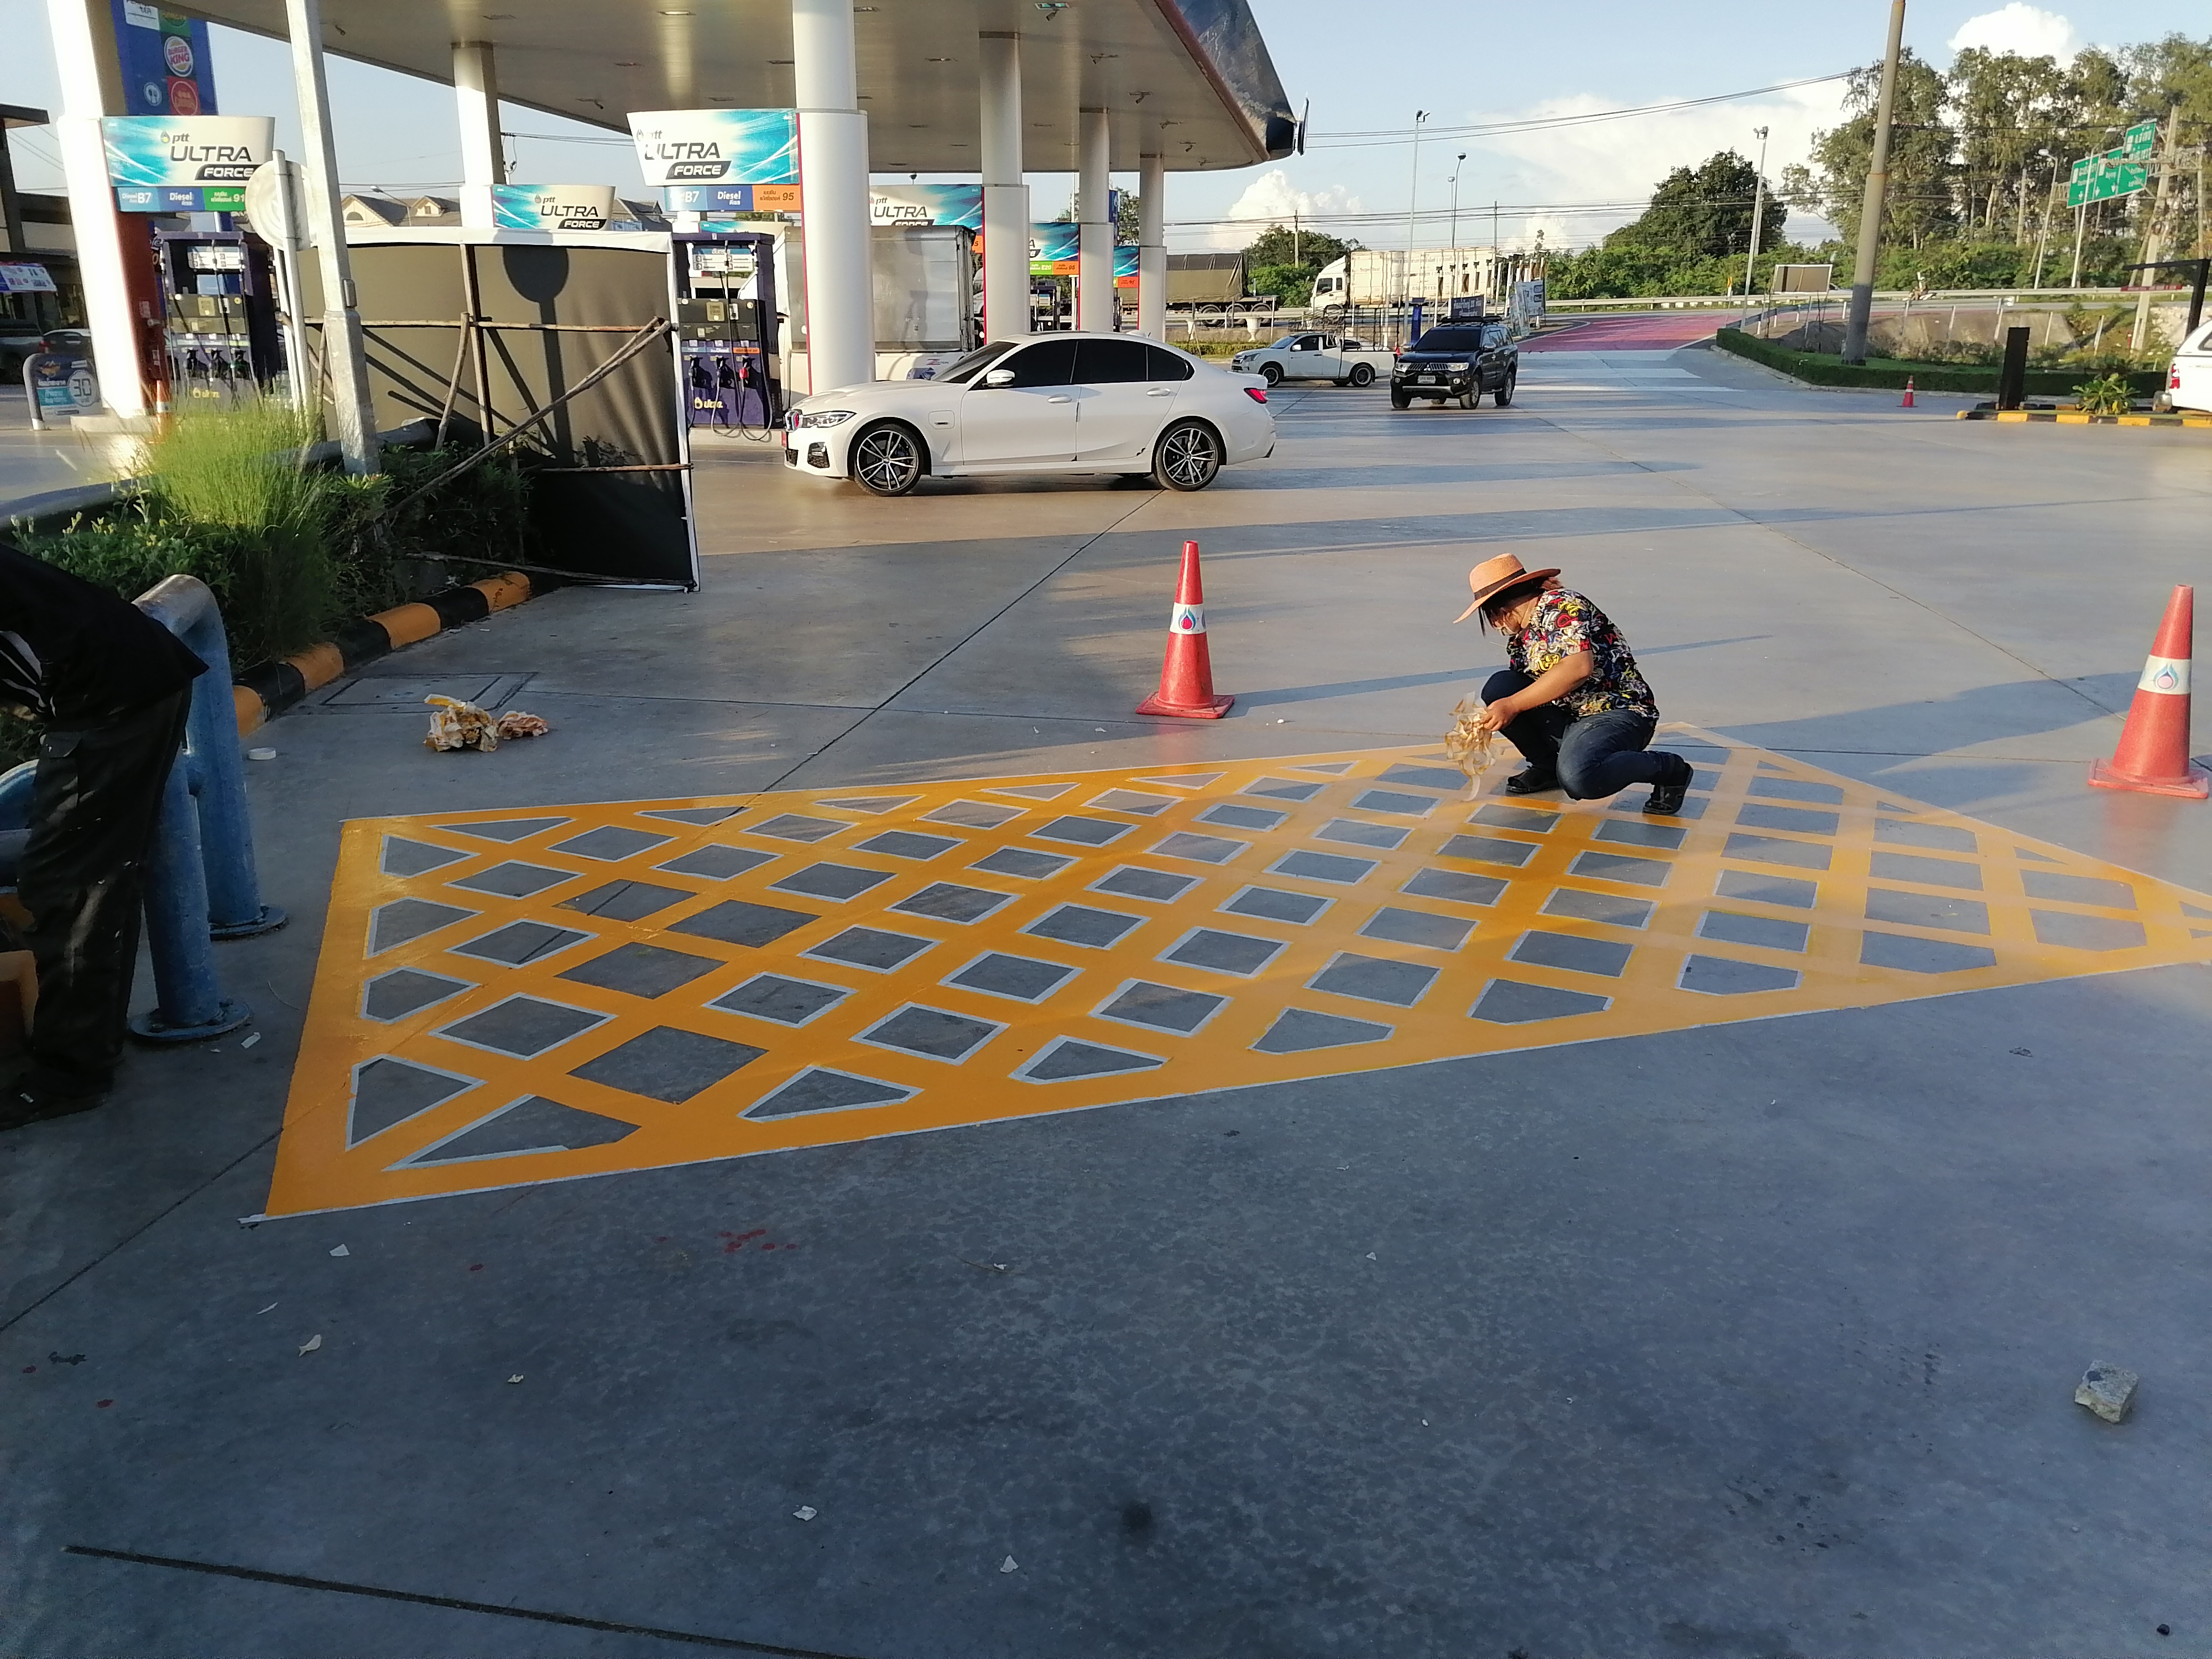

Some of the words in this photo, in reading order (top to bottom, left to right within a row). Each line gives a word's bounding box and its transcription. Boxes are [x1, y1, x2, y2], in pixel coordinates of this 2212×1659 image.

[170, 53, 190, 65] KING
[172, 133, 190, 144] ptt
[170, 145, 252, 162] ULTRA
[644, 142, 721, 160] ULTRA
[204, 167, 254, 178] FORCE
[674, 164, 722, 176] FORCE
[138, 192, 152, 204] B7
[169, 192, 192, 201] Diesel
[233, 194, 245, 202] 91
[685, 191, 700, 203] B7
[717, 191, 741, 200] Diesel
[782, 192, 794, 201] 95
[541, 205, 598, 217] ULTRA
[874, 206, 927, 217] ULTRA
[564, 220, 600, 228] FORCE
[72, 378, 91, 397] 30
